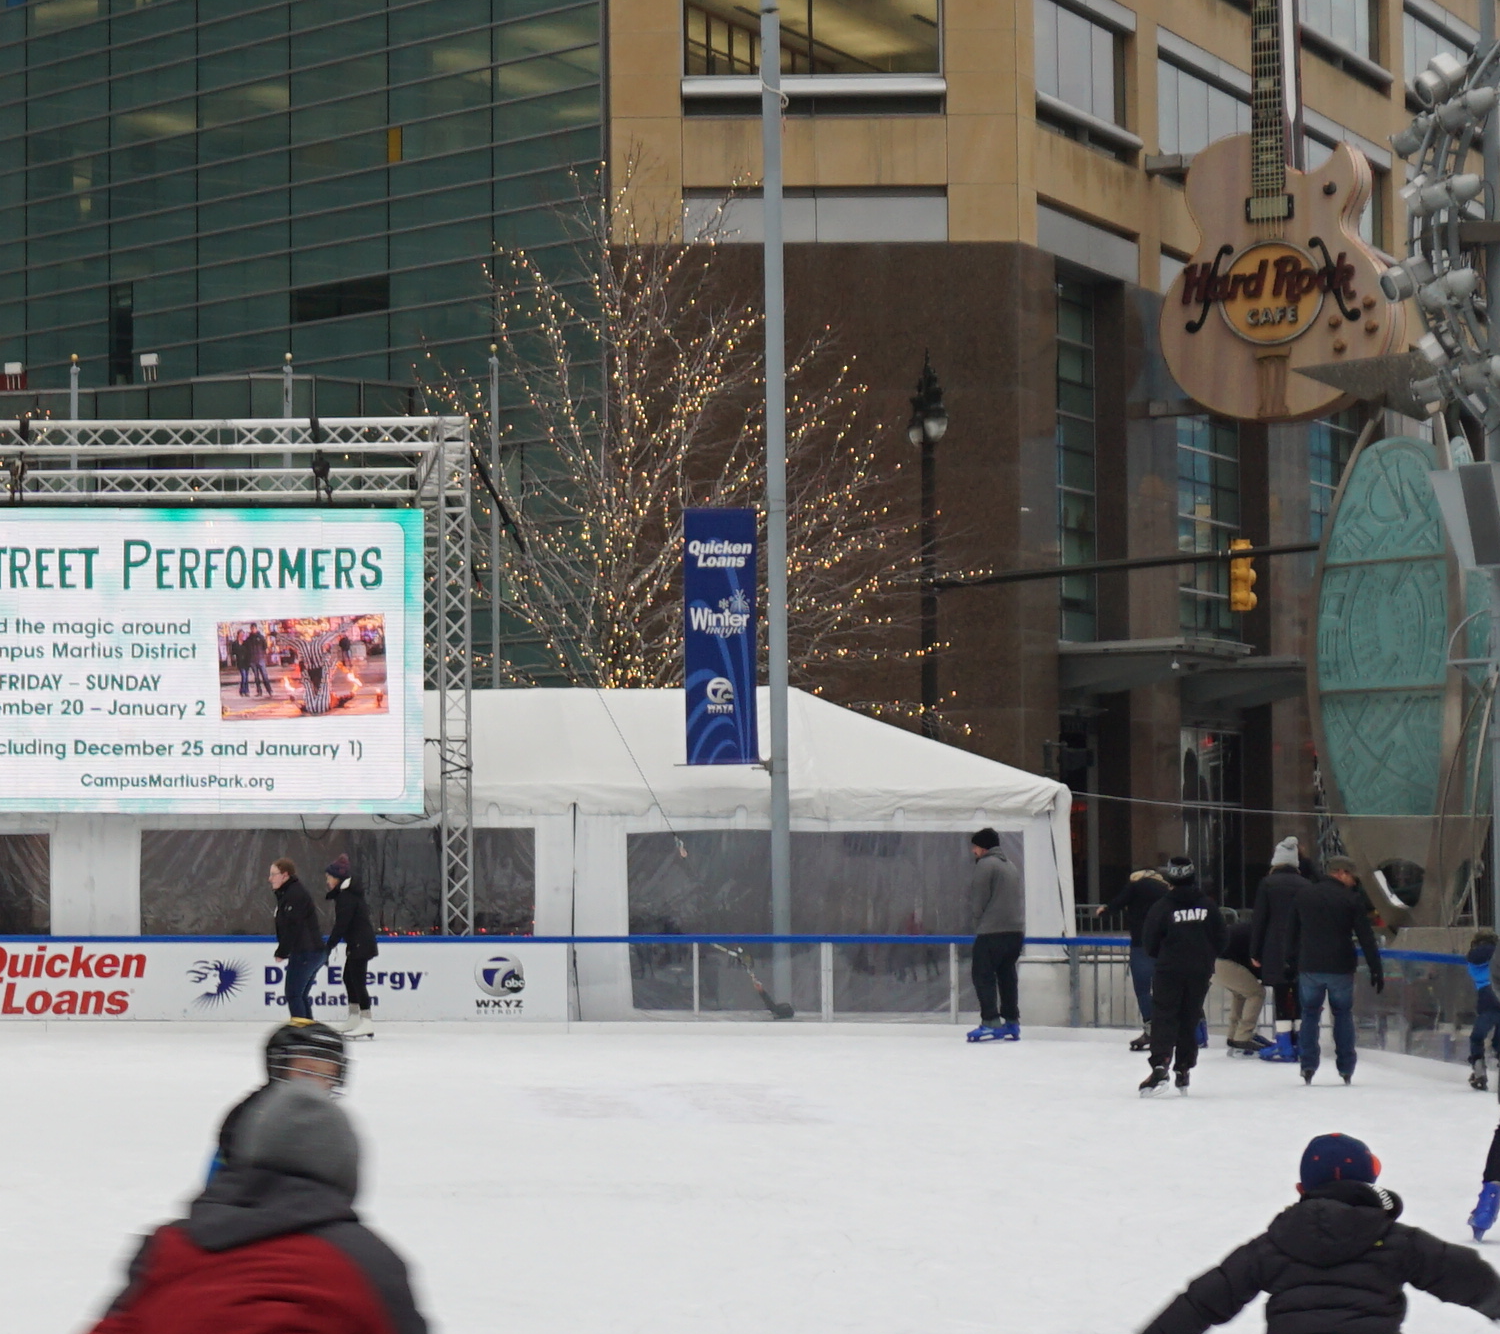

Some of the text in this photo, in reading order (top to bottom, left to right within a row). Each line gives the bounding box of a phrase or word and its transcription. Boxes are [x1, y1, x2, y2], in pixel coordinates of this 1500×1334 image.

[1182, 251, 1357, 305] Hard Rock
[1247, 305, 1299, 327] CAFE
[688, 539, 753, 557] Quicken
[123, 539, 383, 591] PERFORMERS
[697, 553, 746, 568] Loans
[15, 618, 46, 634] the
[52, 618, 114, 639] magic
[122, 619, 191, 635] around
[690, 607, 750, 631] Winter
[705, 625, 746, 638] magic
[52, 642, 123, 659] Martius
[131, 643, 197, 660] District
[86, 674, 161, 692] SUNDAY
[61, 699, 84, 716] 20
[108, 700, 187, 720] January
[195, 700, 205, 716] 2
[74, 739, 174, 757] December
[181, 740, 204, 757] 25
[210, 740, 248, 757] and
[255, 740, 339, 759] Janurary
[349, 740, 363, 760] 1)
[80, 773, 275, 792] CampusMartiusPark.org
[1173, 908, 1208, 923] STAFF
[328, 966, 424, 990] Eergy
[505, 978, 525, 988] abc
[1, 982, 130, 1015] Loans
[475, 999, 524, 1008] WXYZ
